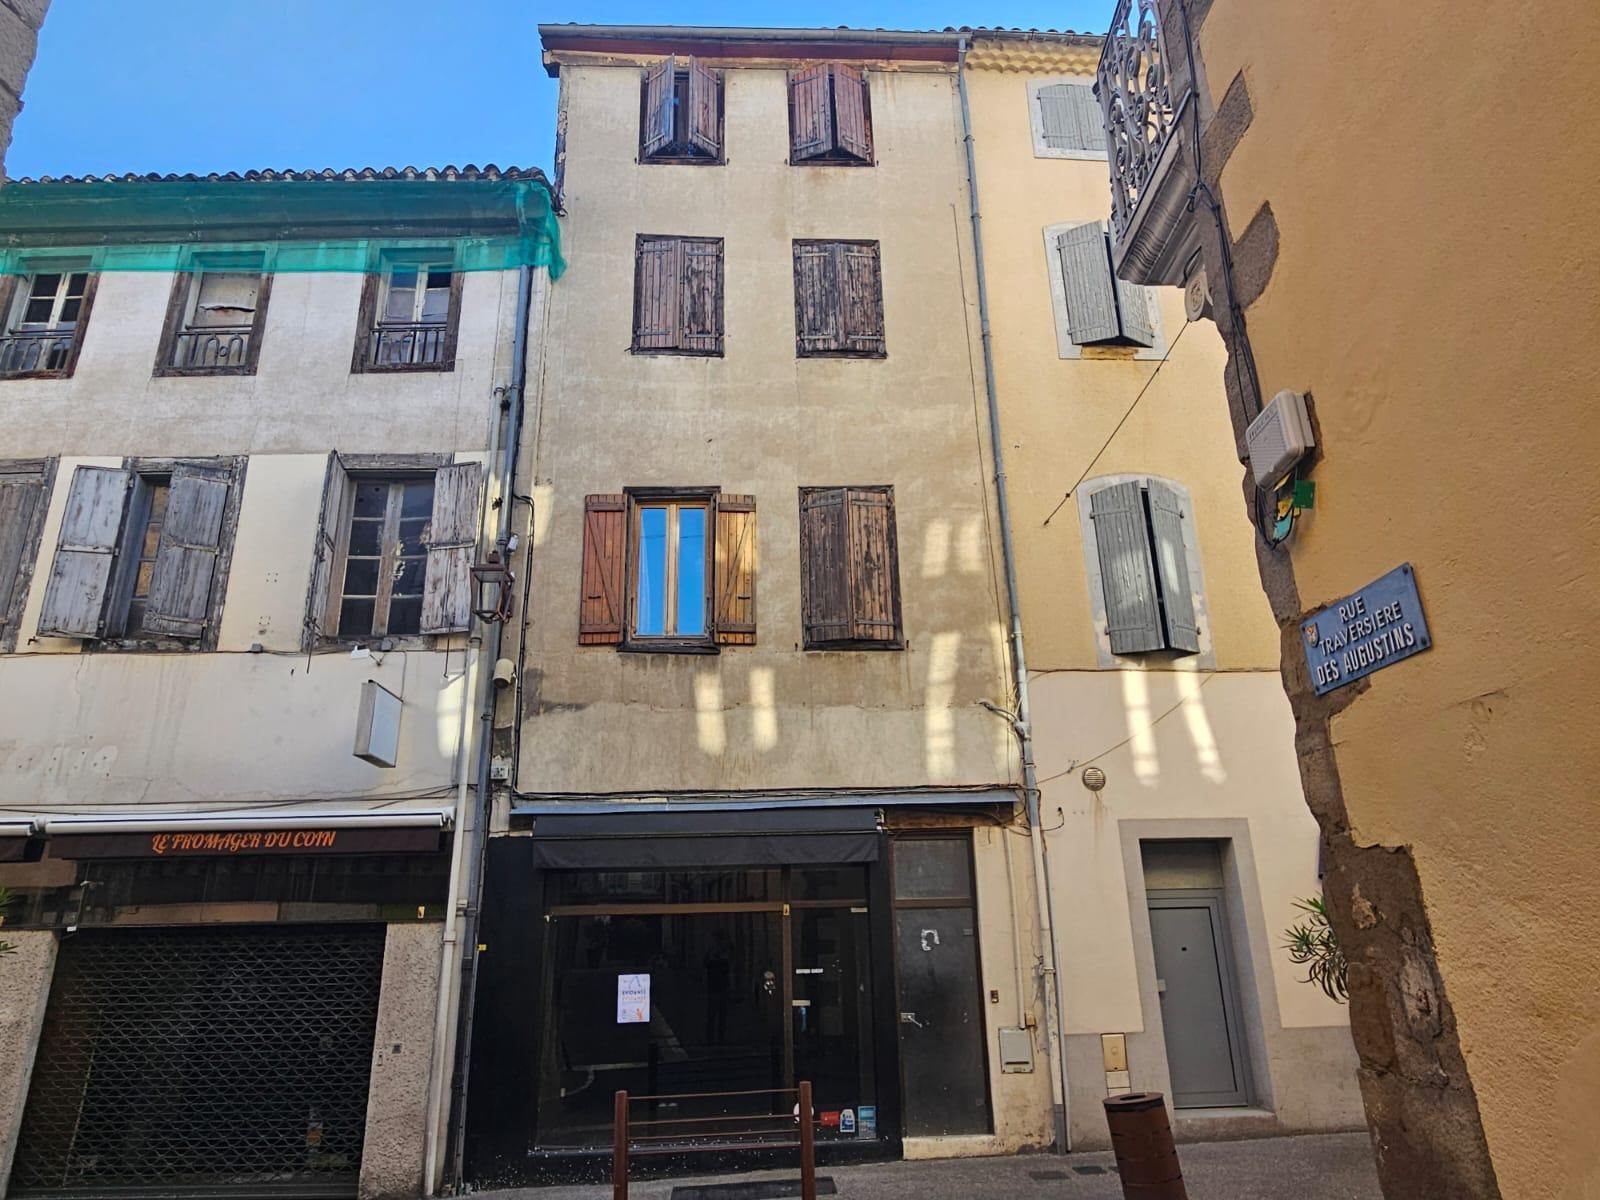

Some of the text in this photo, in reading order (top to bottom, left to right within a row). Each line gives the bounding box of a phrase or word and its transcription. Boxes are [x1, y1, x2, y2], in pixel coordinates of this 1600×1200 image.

[1339, 596, 1365, 623] RUE
[1316, 622, 1415, 685] DES AUGUSTINS
[152, 831, 337, 854] LE FROMAGER DU COIN
